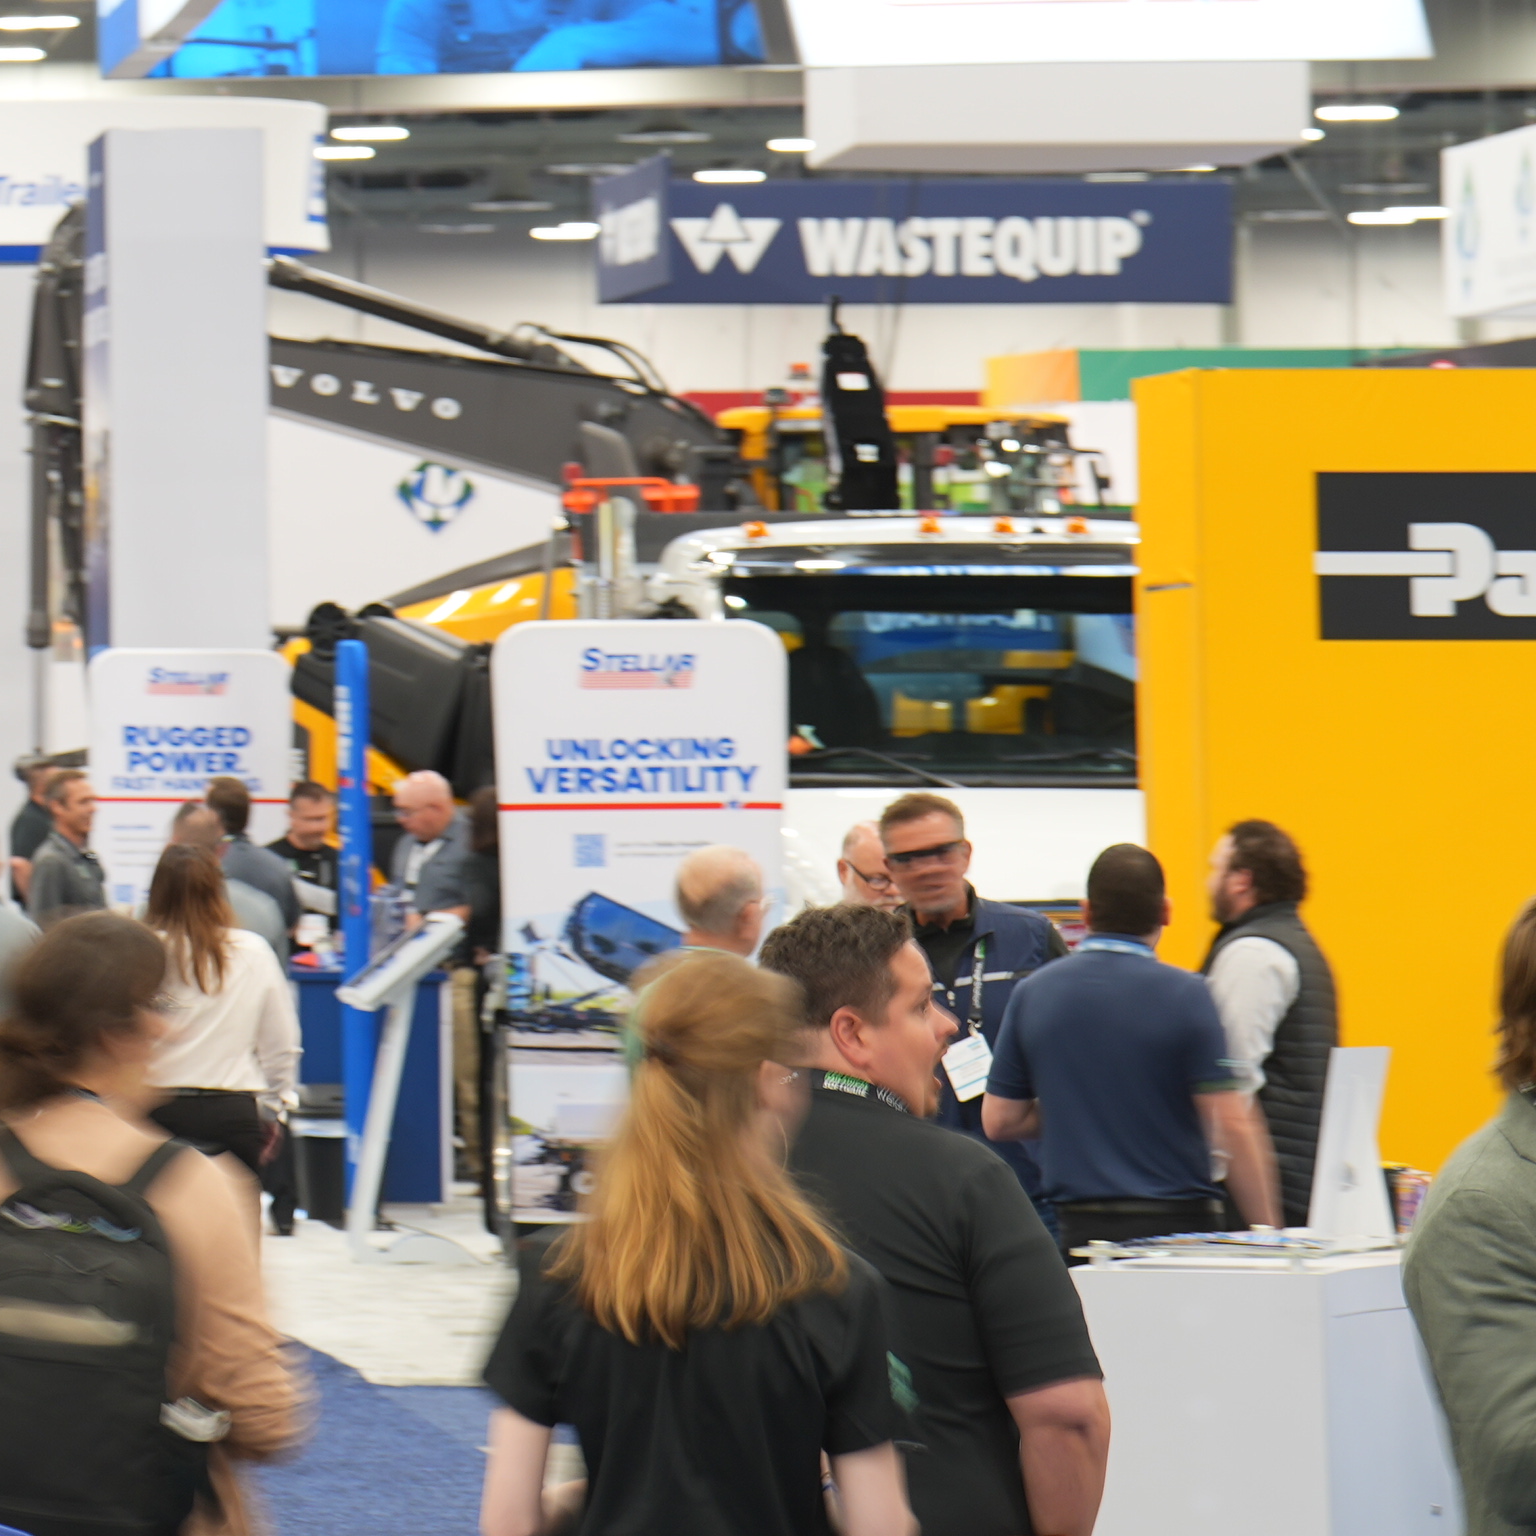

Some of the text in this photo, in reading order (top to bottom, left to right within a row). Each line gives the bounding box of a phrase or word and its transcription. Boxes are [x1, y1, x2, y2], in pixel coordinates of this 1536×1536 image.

[797, 216, 1142, 281] WASTEQUIP
[270, 365, 462, 420] VOLVO
[580, 647, 695, 672] STELLAR
[123, 725, 251, 747] RUGGED
[545, 737, 736, 761] UNLOCKING
[525, 765, 758, 793] VERSATILITY
